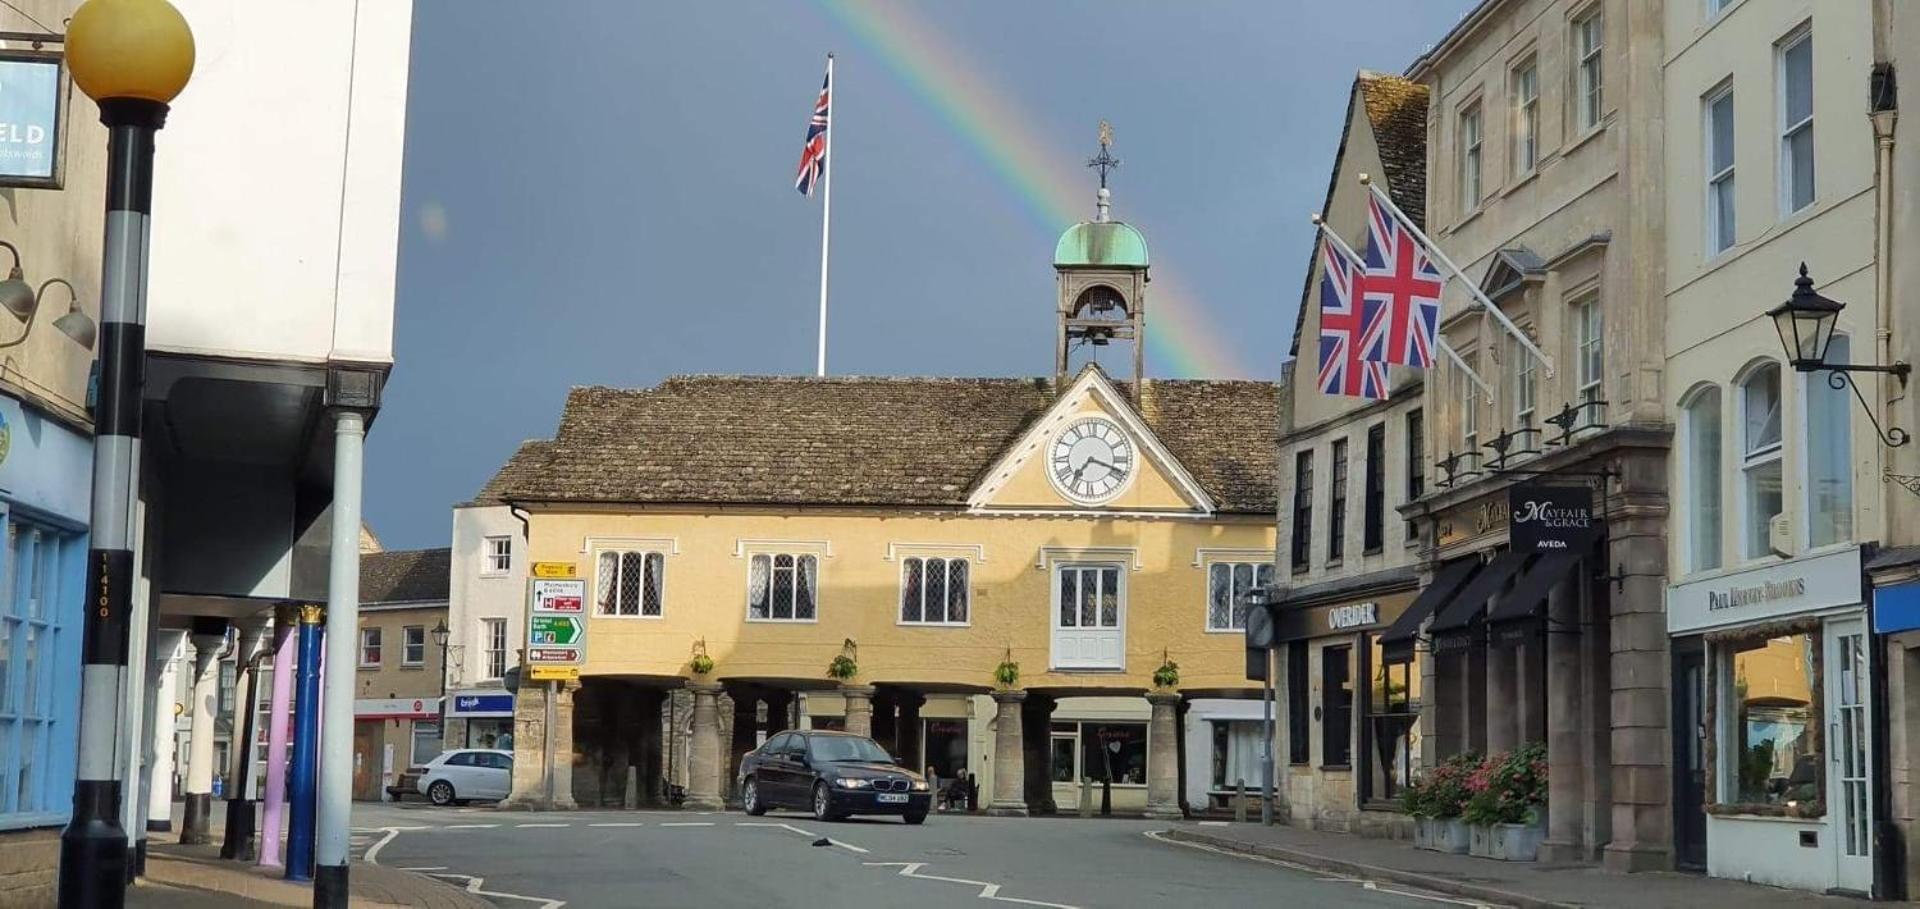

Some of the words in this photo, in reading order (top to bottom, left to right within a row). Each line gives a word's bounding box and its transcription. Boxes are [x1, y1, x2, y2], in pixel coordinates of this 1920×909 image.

[1514, 501, 1589, 523] MAYFAIR
[1537, 540, 1567, 548] AVEDA
[100, 552, 108, 617] 114100
[1328, 602, 1377, 630] OVERIDER
